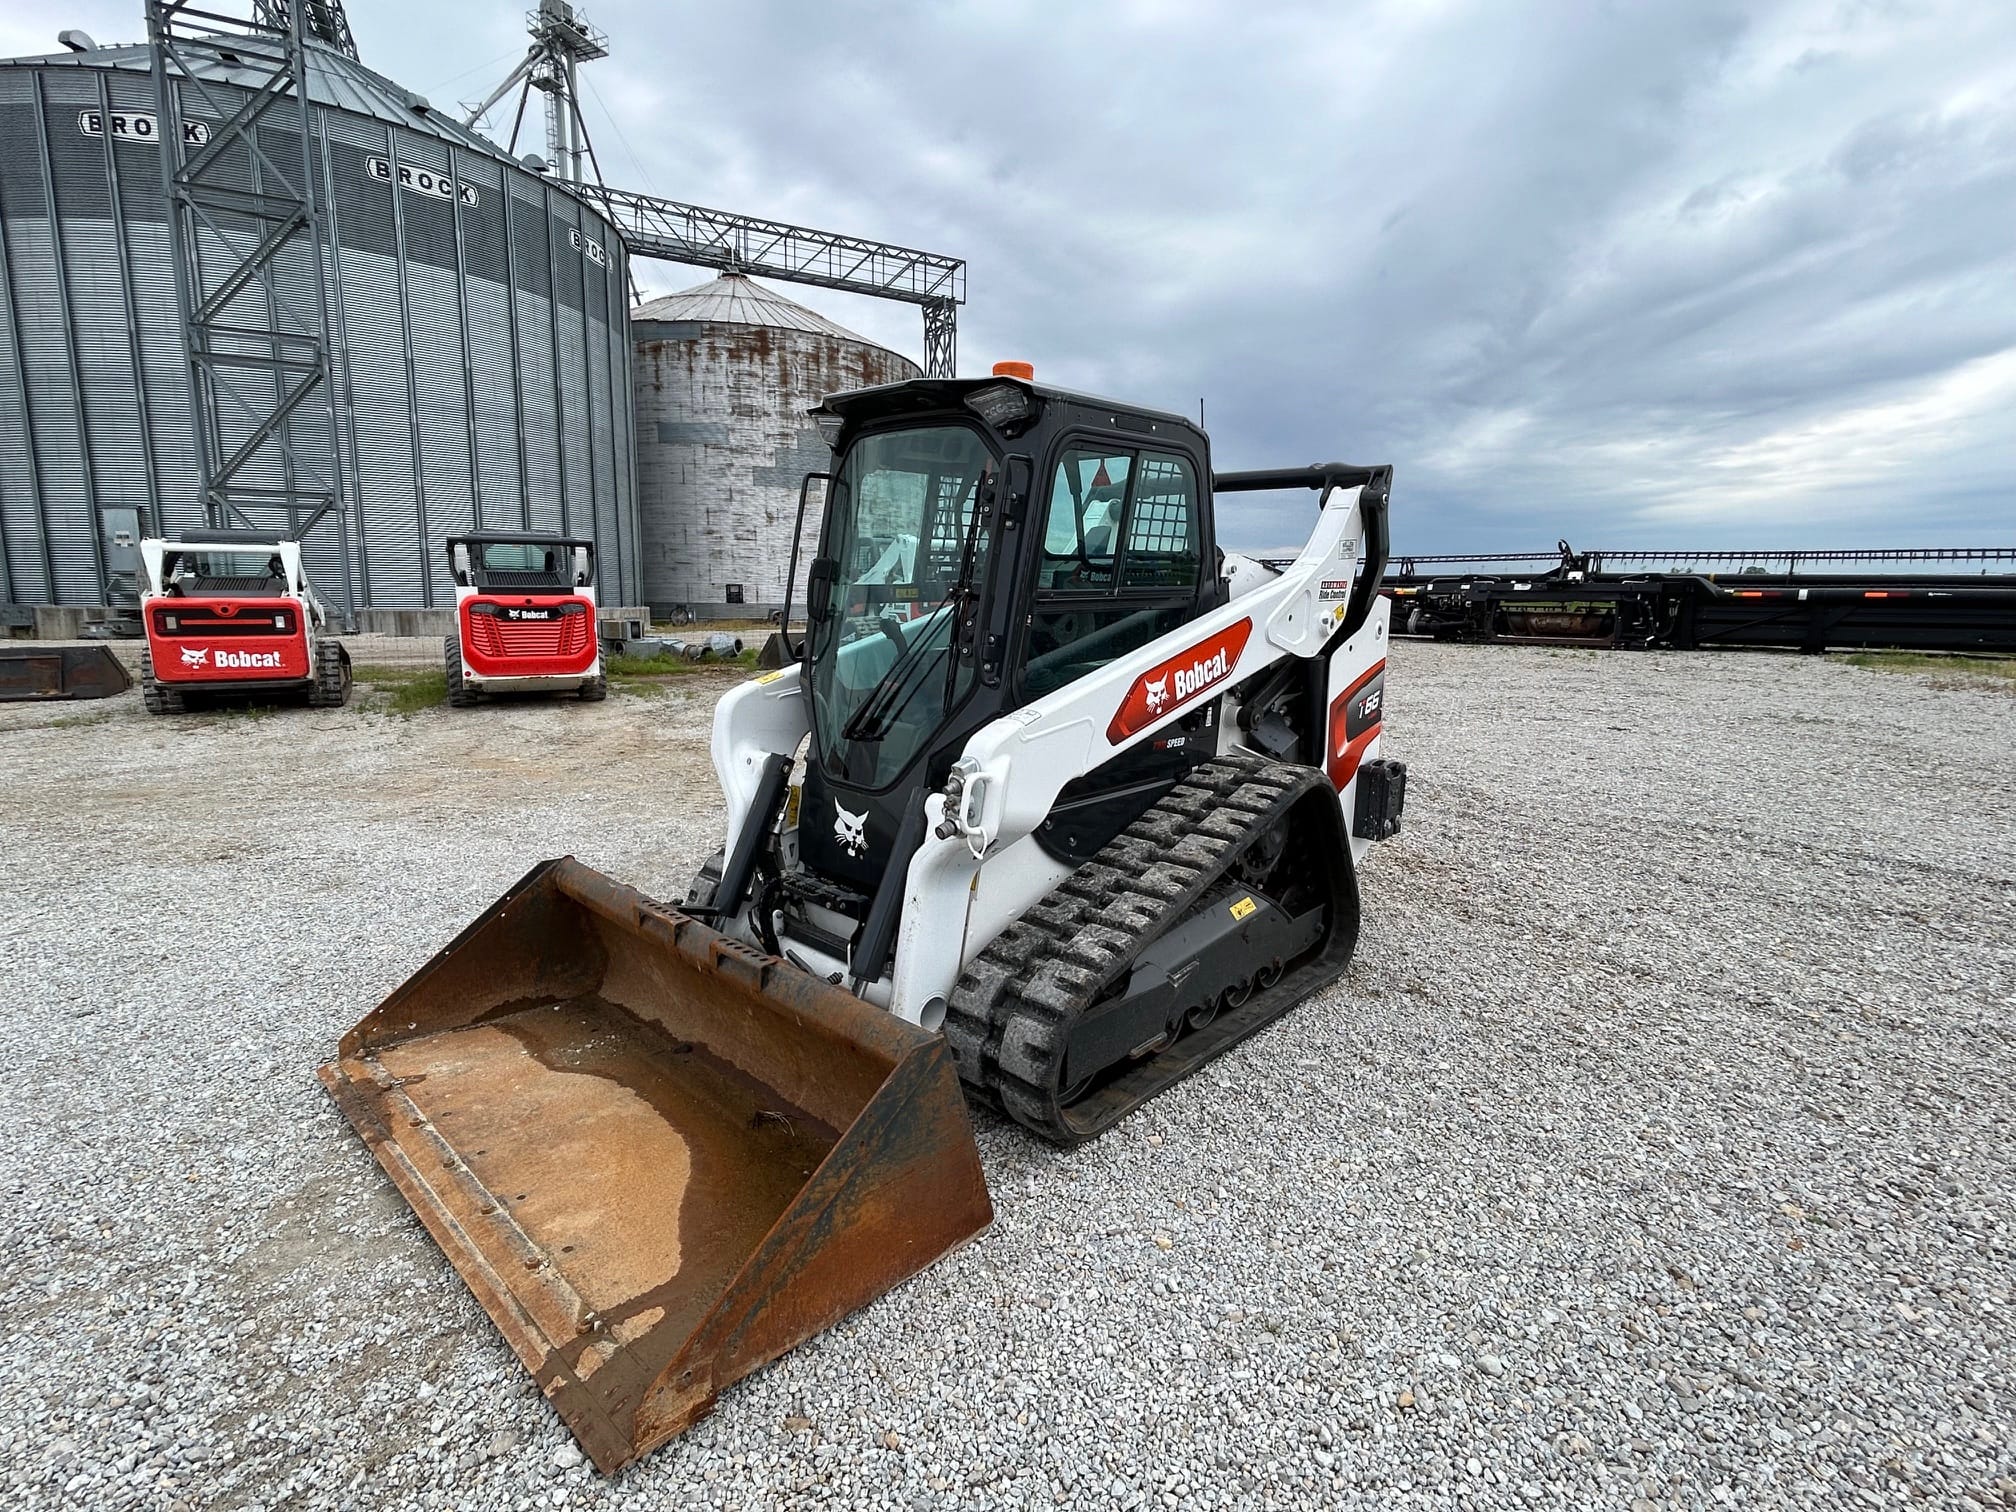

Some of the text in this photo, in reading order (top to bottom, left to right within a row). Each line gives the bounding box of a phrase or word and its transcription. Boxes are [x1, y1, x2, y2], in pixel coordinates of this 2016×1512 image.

[88, 114, 201, 142] BROK
[376, 160, 471, 203] BROCK
[1090, 571, 1112, 582] Bobca
[521, 610, 549, 619] Bobcat
[214, 650, 283, 668] Bobcat
[1174, 646, 1228, 701] Bobcat
[1358, 690, 1381, 719] T66
[1167, 736, 1186, 749] SPEED
